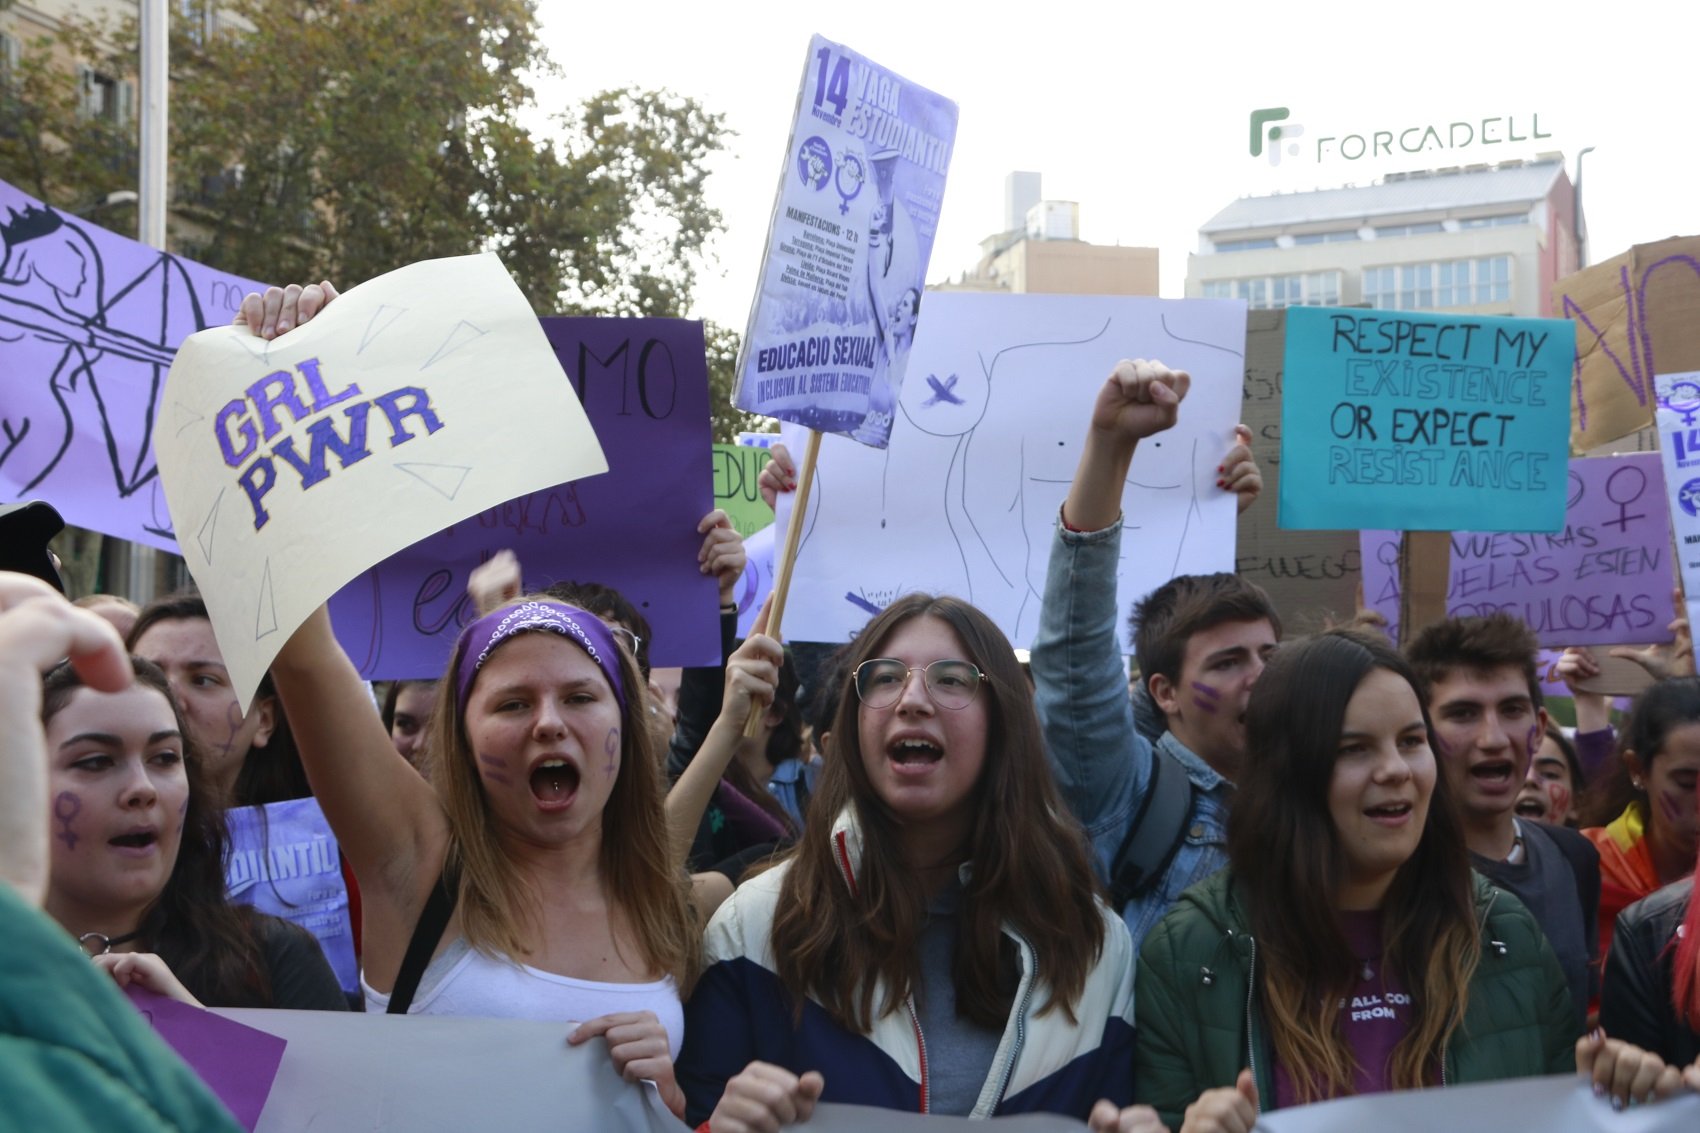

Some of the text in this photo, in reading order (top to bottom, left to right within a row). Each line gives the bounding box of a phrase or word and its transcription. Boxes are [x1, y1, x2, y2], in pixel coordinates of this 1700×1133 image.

[813, 47, 851, 116] 14
[856, 63, 900, 117] VAGA
[811, 104, 843, 129] Novembre
[846, 102, 949, 175] ESTUDIANTIL
[1317, 113, 1552, 163] FORCADELL
[786, 206, 841, 236] MANIFESTACIONS
[846, 229, 853, 242] 12
[833, 336, 876, 369] SEXUAL
[1330, 314, 1548, 368] RESPECT MY
[574, 337, 677, 420] MO
[757, 375, 795, 404] INCLUSIVA
[798, 374, 807, 395] AL
[810, 371, 840, 394] SISTEMA
[214, 356, 363, 470] GRL
[1330, 402, 1515, 447] OR EXPECT
[237, 385, 445, 533] PWR
[1575, 546, 1660, 581] ESTEN
[227, 839, 336, 885] DIANTIL
[1351, 994, 1381, 1008] ALL
[1351, 1006, 1395, 1021] FROM
